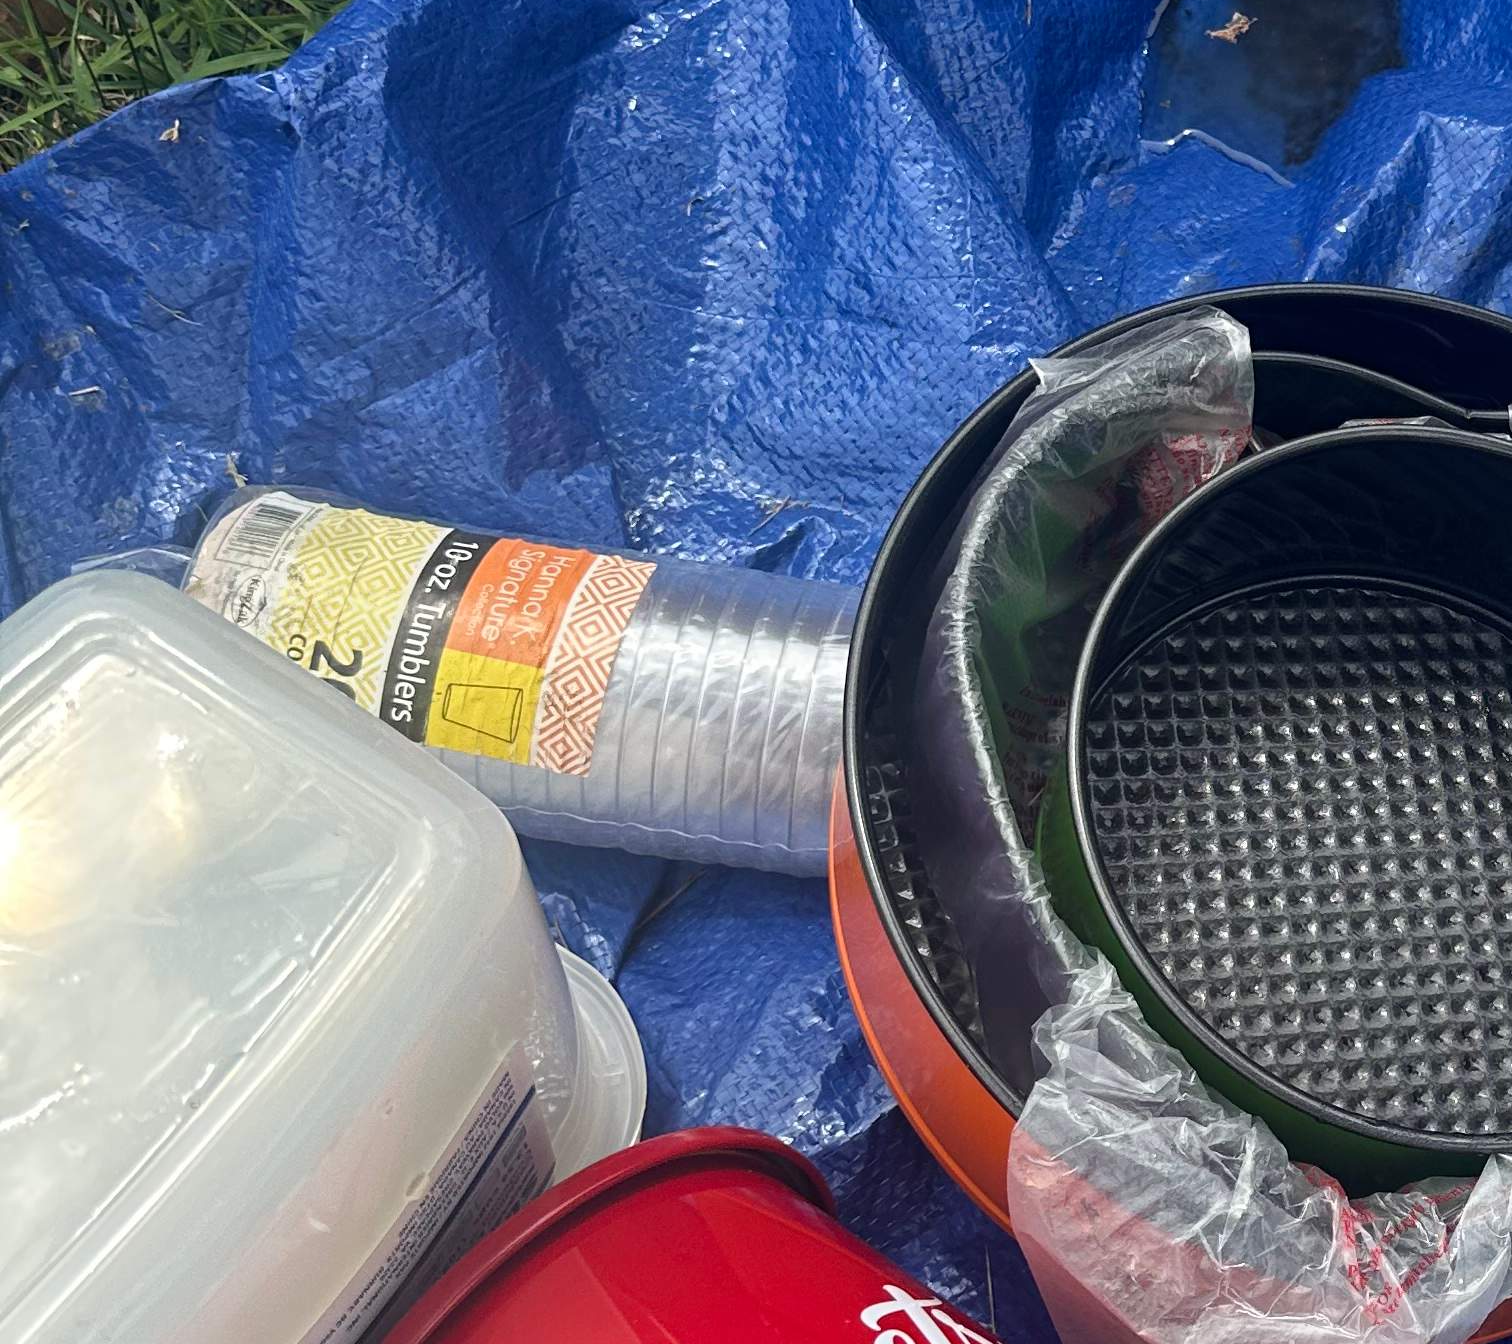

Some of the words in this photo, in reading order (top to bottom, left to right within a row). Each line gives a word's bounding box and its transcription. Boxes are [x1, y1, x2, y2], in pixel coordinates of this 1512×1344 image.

[424, 563, 457, 594] oz.
[481, 548, 546, 642] Signature
[522, 556, 577, 617] Hanna
[391, 602, 447, 723] Tumblers
